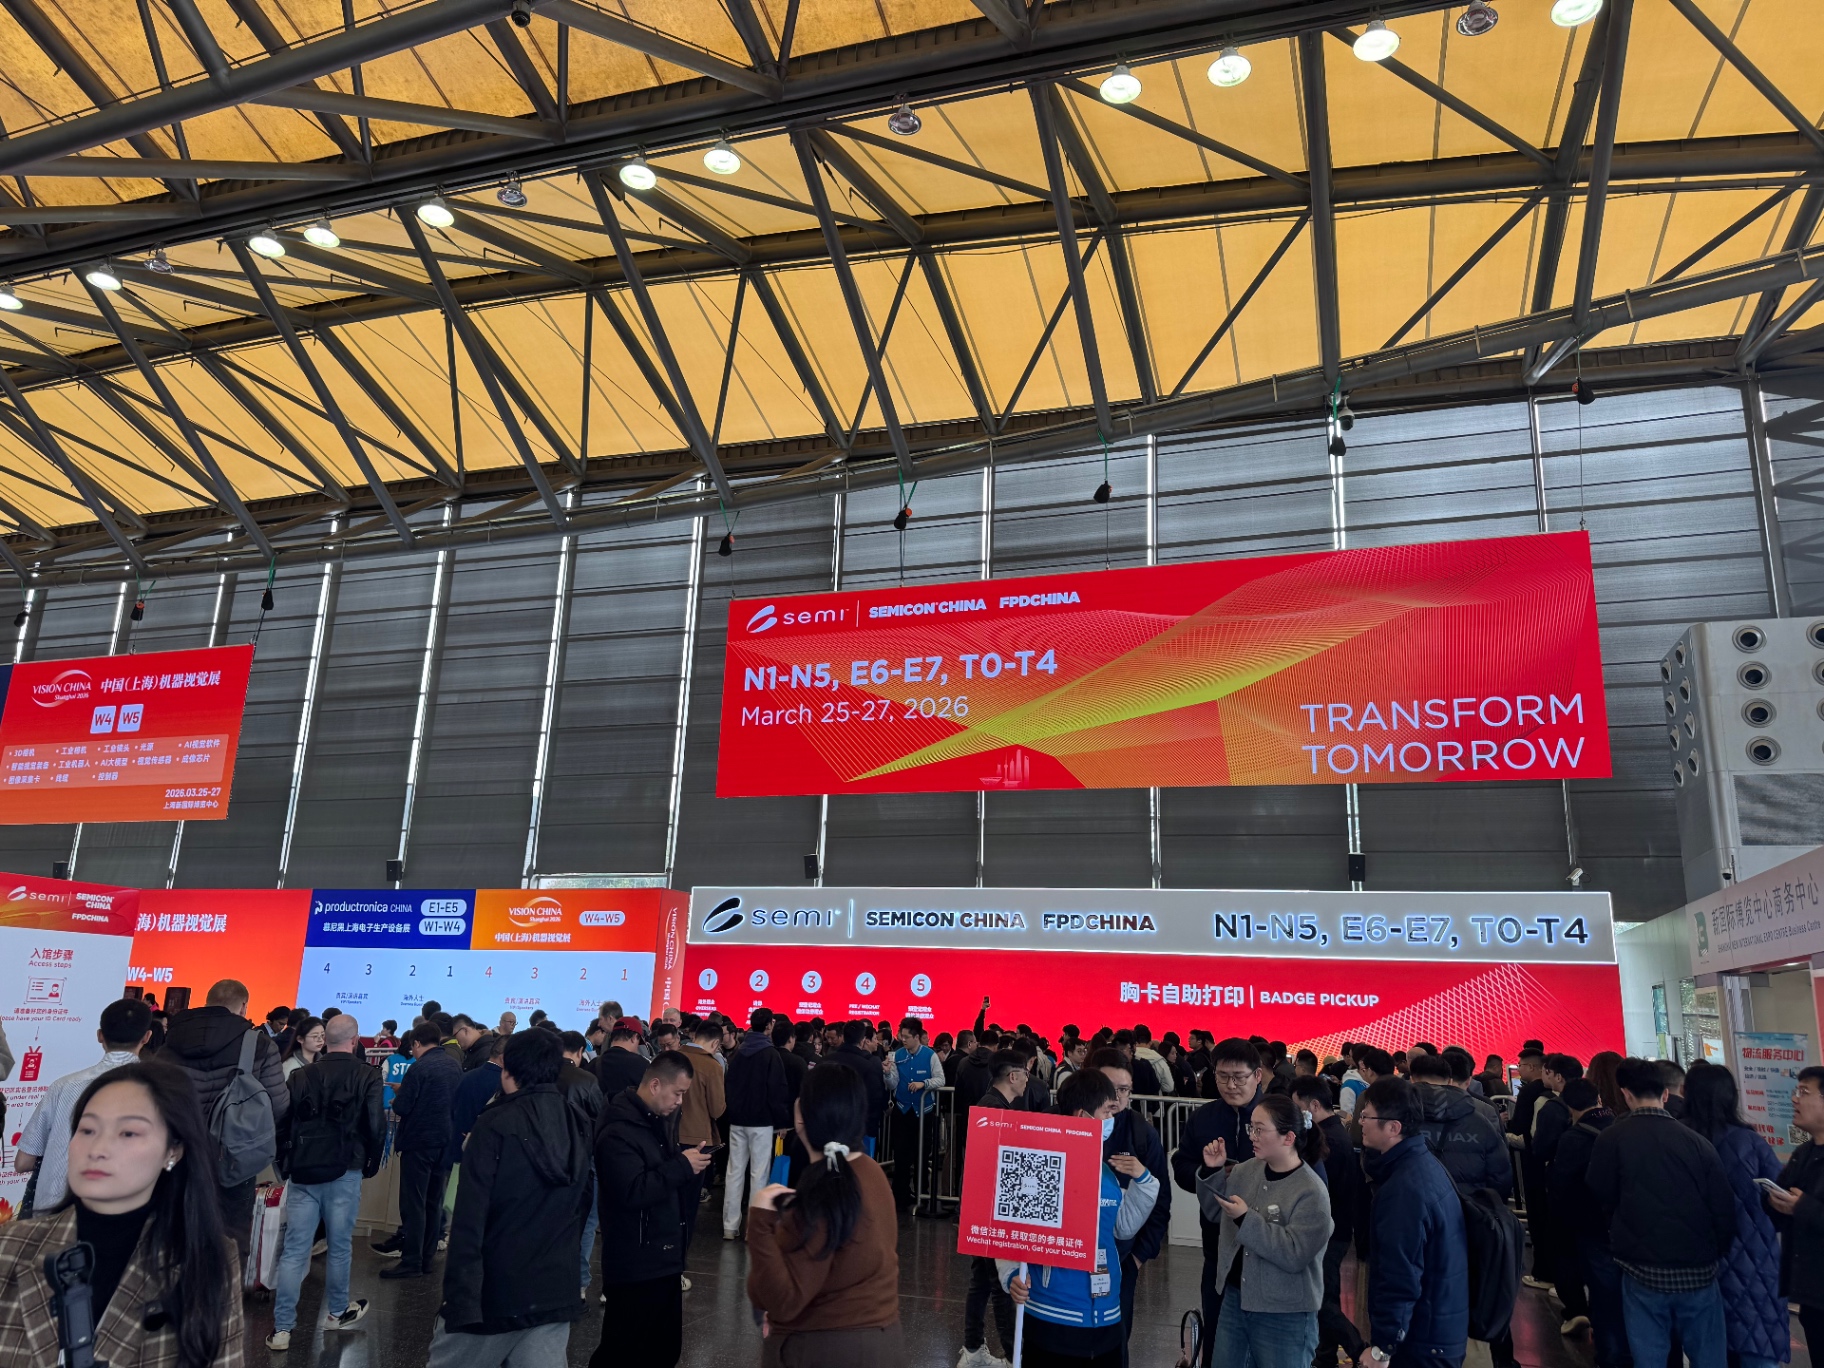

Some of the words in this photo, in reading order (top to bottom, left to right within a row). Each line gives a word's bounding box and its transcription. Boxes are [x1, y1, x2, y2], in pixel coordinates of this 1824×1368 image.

[783, 609, 846, 625] semi
[869, 602, 936, 619] SEMICON
[939, 599, 986, 614] CHINA
[999, 591, 1080, 608] FPDCHINA
[744, 663, 838, 691] N1-N5,
[851, 656, 948, 685] E6-E7,
[33, 683, 62, 694] VISION
[63, 681, 92, 692] CHINA
[100, 670, 222, 693] 中国(上海)机器视觉展
[741, 705, 811, 726] March
[820, 700, 893, 724] 25-27,
[904, 696, 969, 719] 2026
[1300, 693, 1584, 733] TRANSFORM
[94, 713, 112, 727] W4
[122, 711, 140, 725] W5
[1302, 737, 1585, 774] TOMORROW
[165, 786, 222, 798] 2026.03.25-27
[29, 891, 65, 903] semi
[76, 892, 114, 903] SEMICON
[85, 901, 111, 910] CHINA
[325, 901, 388, 914] productronica
[390, 904, 413, 913] CHINA
[428, 902, 459, 913] E1-E5
[509, 907, 536, 916] VISION
[536, 907, 563, 916] CHINA
[71, 913, 109, 923] FPDCHINA
[134, 913, 227, 932] 海)机器视觉展
[584, 913, 620, 923] W4-W5
[323, 922, 411, 933] 慕尼黑上海电子生产设备展
[424, 920, 460, 932] W1-W4
[751, 908, 832, 926] semi
[866, 911, 955, 928] SEMICON
[960, 912, 1026, 929] CHINA
[1043, 912, 1156, 932] FPDCHINA
[1214, 913, 1329, 946] N1-N5,
[1342, 915, 1459, 948] E6-E7,
[1788, 924, 1807, 937] Business
[1806, 920, 1821, 933] Centre
[30, 947, 74, 961] 入馆步骤
[28, 960, 52, 968] Access
[53, 960, 72, 969] steps
[323, 962, 331, 974] 4
[365, 963, 373, 976] 3
[409, 964, 416, 977] 2
[447, 965, 453, 977] 1
[126, 966, 174, 983] W4-W5
[485, 966, 492, 978] 4
[531, 967, 539, 979] 3
[580, 967, 587, 980] 2
[621, 968, 628, 981] 1
[706, 973, 712, 985] 1
[755, 974, 764, 987] 2
[807, 975, 816, 989] 3
[861, 977, 870, 990] 4
[916, 979, 925, 992] 5
[1120, 980, 1245, 1007] 胸卡自助打印
[1260, 990, 1316, 1006] BADGE
[1320, 993, 1380, 1008] PICKUP
[1742, 1047, 1804, 1061] 物流服务中心
[990, 1120, 1013, 1128] semi
[1020, 1124, 1044, 1132] SEMICON
[1044, 1126, 1061, 1134] CHINA
[966, 1235, 991, 1245] Wechat
[992, 1239, 1031, 1251] registration,
[1031, 1244, 1044, 1252] Get
[1045, 1247, 1061, 1255] your
[1061, 1248, 1087, 1259] badges
